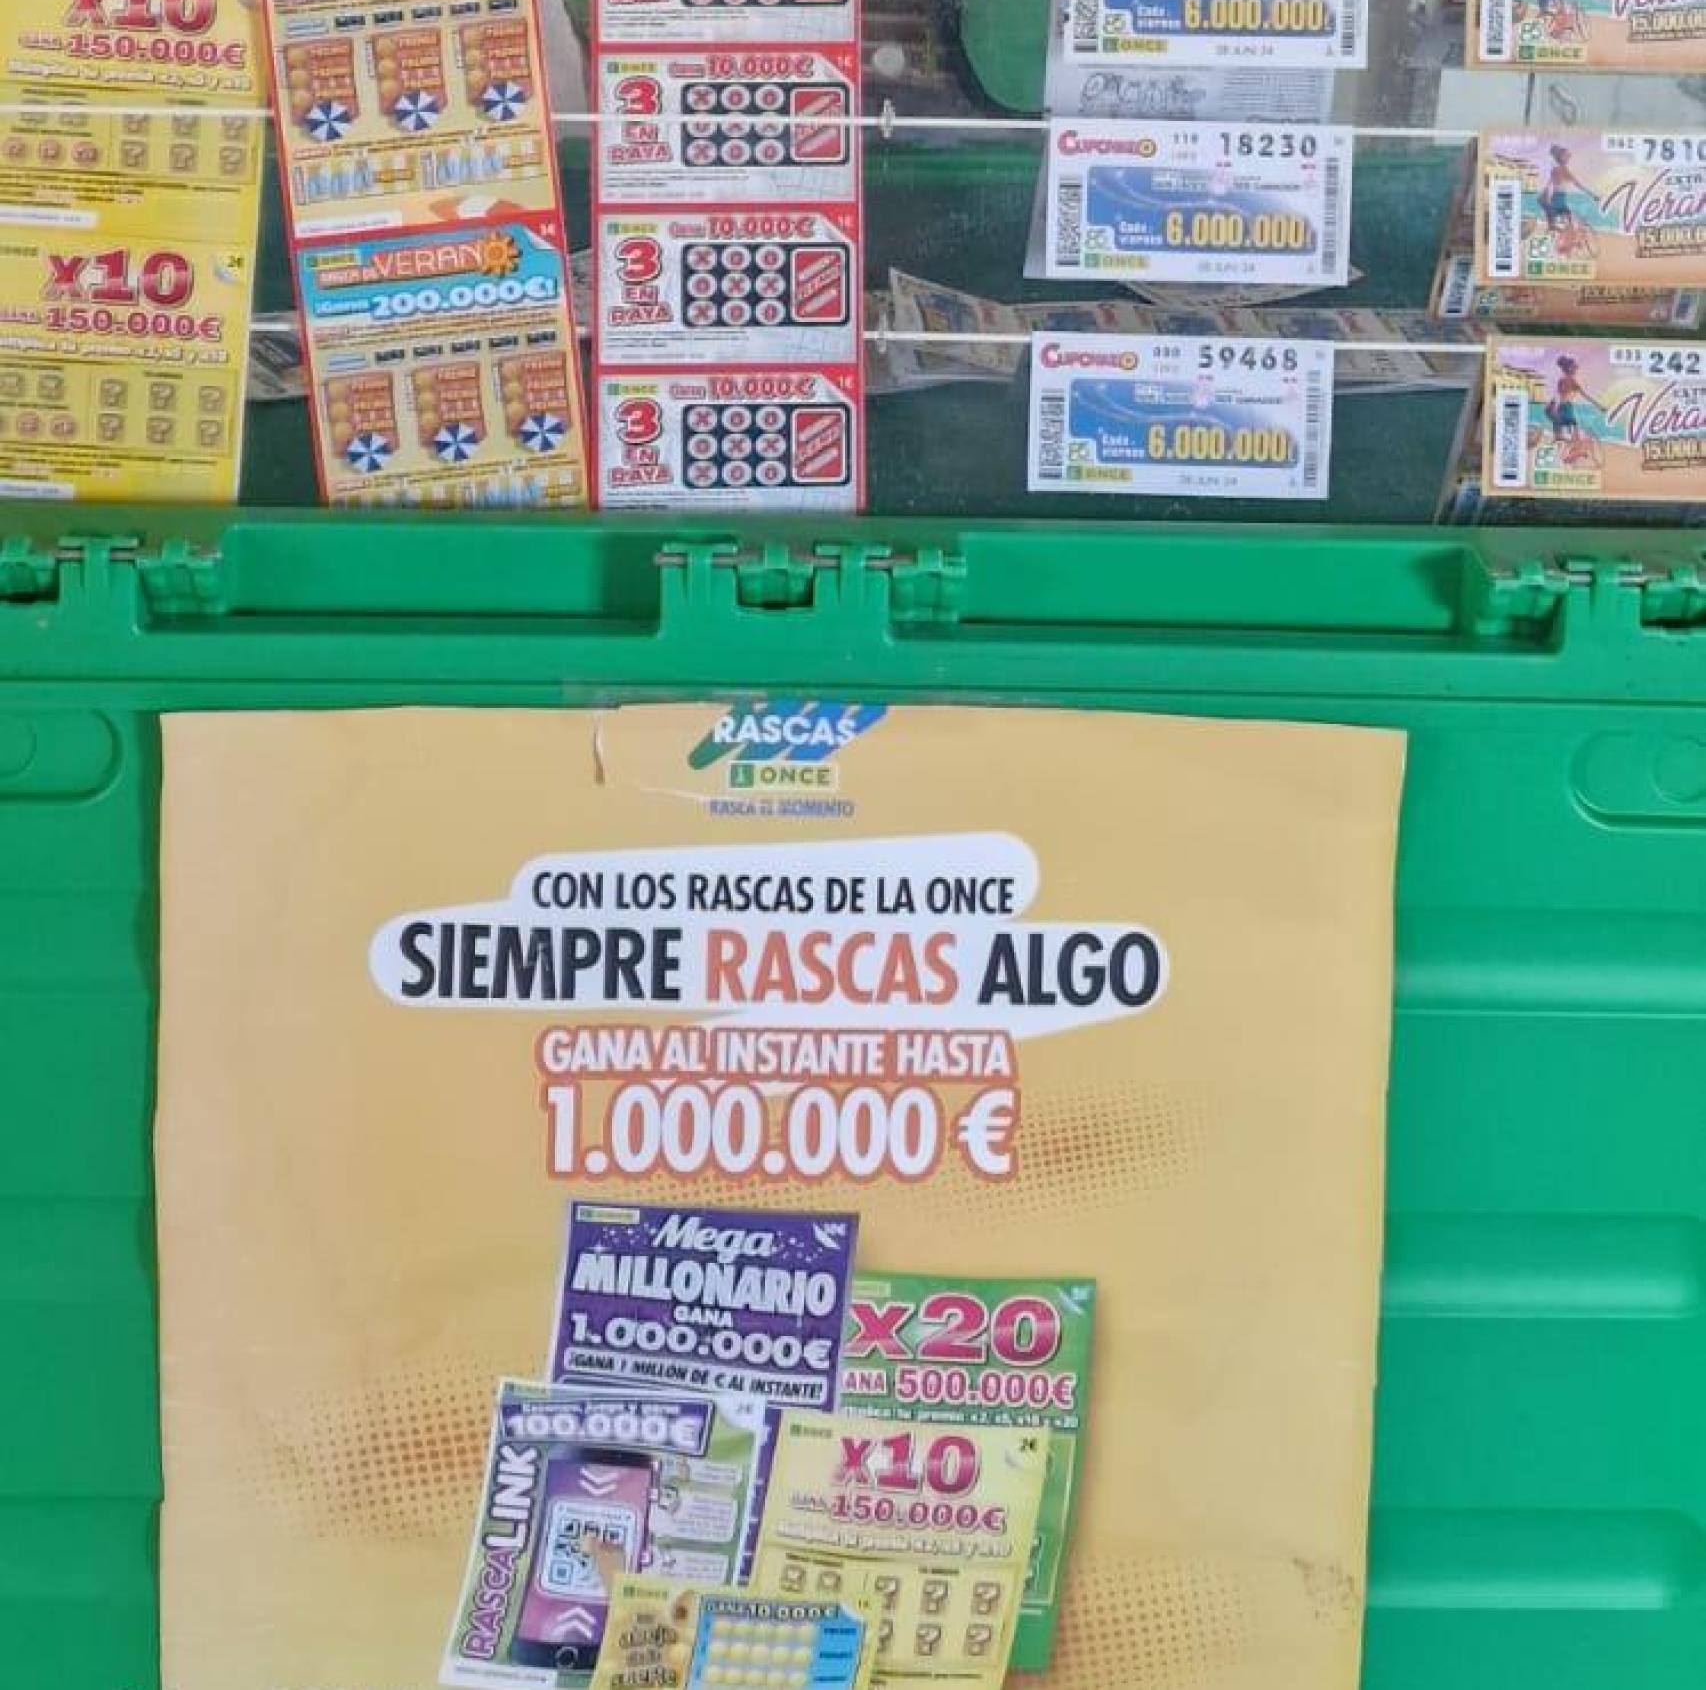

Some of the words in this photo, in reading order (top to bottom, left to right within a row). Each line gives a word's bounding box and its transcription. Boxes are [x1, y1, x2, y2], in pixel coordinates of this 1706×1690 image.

[67, 33, 247, 69] 150.000€
[1120, 39, 1168, 53] ONCE
[1536, 46, 1583, 59] ONCE
[706, 54, 816, 80] 10.000€
[607, 142, 673, 165] RAYA
[1220, 132, 1316, 158] 18230
[707, 216, 817, 240] 10.000€
[615, 236, 662, 284] 3
[1546, 263, 1589, 274] ONCE
[621, 285, 659, 306] EN
[46, 309, 222, 342] 150.000€
[607, 302, 674, 328] RAYA
[1198, 344, 1298, 371] 59468
[708, 376, 817, 401] 10.000€
[615, 397, 662, 445] 3
[607, 464, 674, 490] RAYA
[1552, 472, 1595, 485] ONCE
[712, 714, 858, 746] RASCAS
[760, 767, 832, 786] ONCE
[532, 871, 604, 911] CON
[614, 873, 677, 912] LOS
[686, 873, 814, 914] RASCAS
[824, 875, 865, 913] DE
[875, 877, 917, 913] LA
[924, 876, 1015, 915] ONCE
[400, 921, 683, 1003] SIEMPRE
[705, 929, 959, 1005] RASCAS
[976, 930, 1161, 1008] ALGO
[541, 1030, 651, 1073] GANA
[656, 1034, 706, 1074] AL
[713, 1033, 885, 1077] INSTANTE
[894, 1036, 1011, 1078] HASTA
[545, 1084, 940, 1176] 1.000.000
[957, 1088, 1017, 1178] €
[652, 1214, 777, 1264] Mega
[571, 1253, 837, 1317] MILLONARIO
[672, 1306, 734, 1328] GANA
[570, 1312, 833, 1370] 1.000.000€
[842, 1369, 887, 1395] ANA
[895, 1365, 1077, 1410] 500.000€
[503, 1412, 704, 1448] 100.000€
[831, 1494, 1008, 1536] 150.000€
[459, 1444, 542, 1660] RASCALINK
